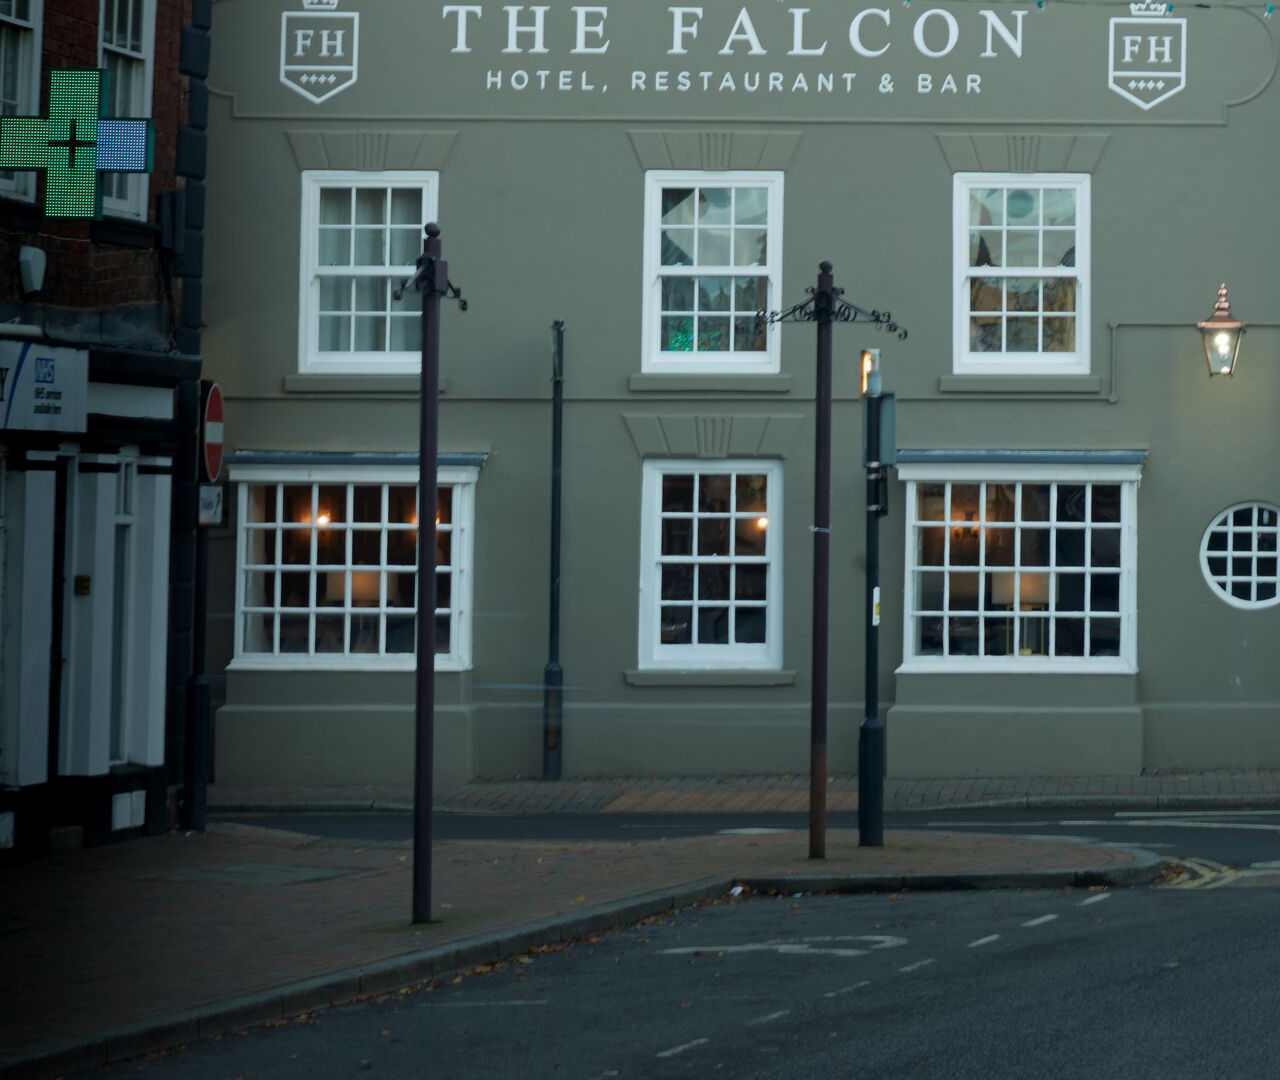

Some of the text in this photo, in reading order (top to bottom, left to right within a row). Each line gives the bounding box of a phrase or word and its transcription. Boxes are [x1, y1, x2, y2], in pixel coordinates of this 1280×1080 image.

[294, 29, 345, 57] FH
[442, 5, 1029, 58] THE FALCON
[1122, 35, 1173, 63] FH
[486, 70, 982, 94] HOTEL, RESTAURANT & BAR
